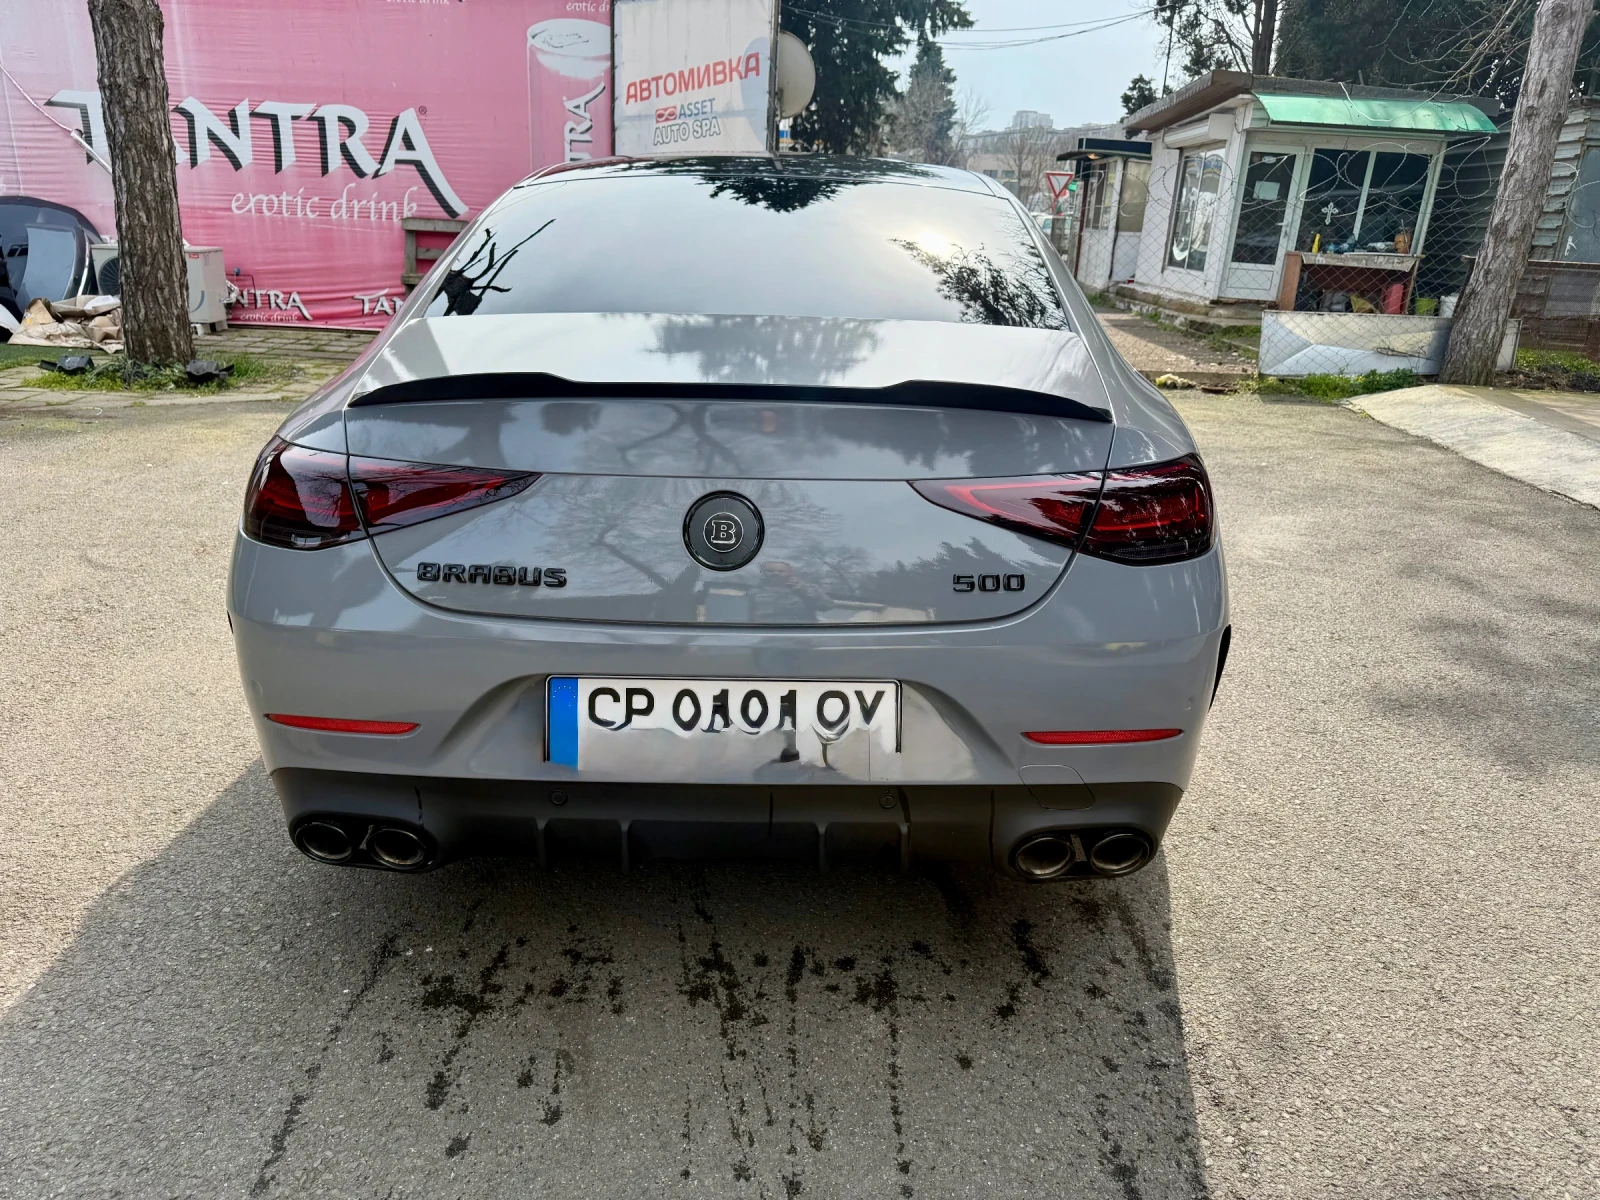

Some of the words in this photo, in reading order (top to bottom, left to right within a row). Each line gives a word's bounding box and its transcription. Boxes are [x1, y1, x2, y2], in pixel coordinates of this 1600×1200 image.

[566, 1, 596, 12] erotic
[625, 52, 760, 105] АВТОМИВКА
[678, 98, 716, 119] ASSET
[653, 122, 690, 146] AUTO
[693, 116, 721, 140] SPA
[44, 90, 468, 218] TNTRA
[231, 187, 320, 218] erotic
[330, 183, 418, 221] drink
[240, 311, 268, 322] erotic
[271, 311, 298, 323] drink
[711, 520, 736, 544] B
[417, 562, 567, 588] BRABUS
[953, 573, 1025, 592] 500
[588, 687, 655, 731] CP
